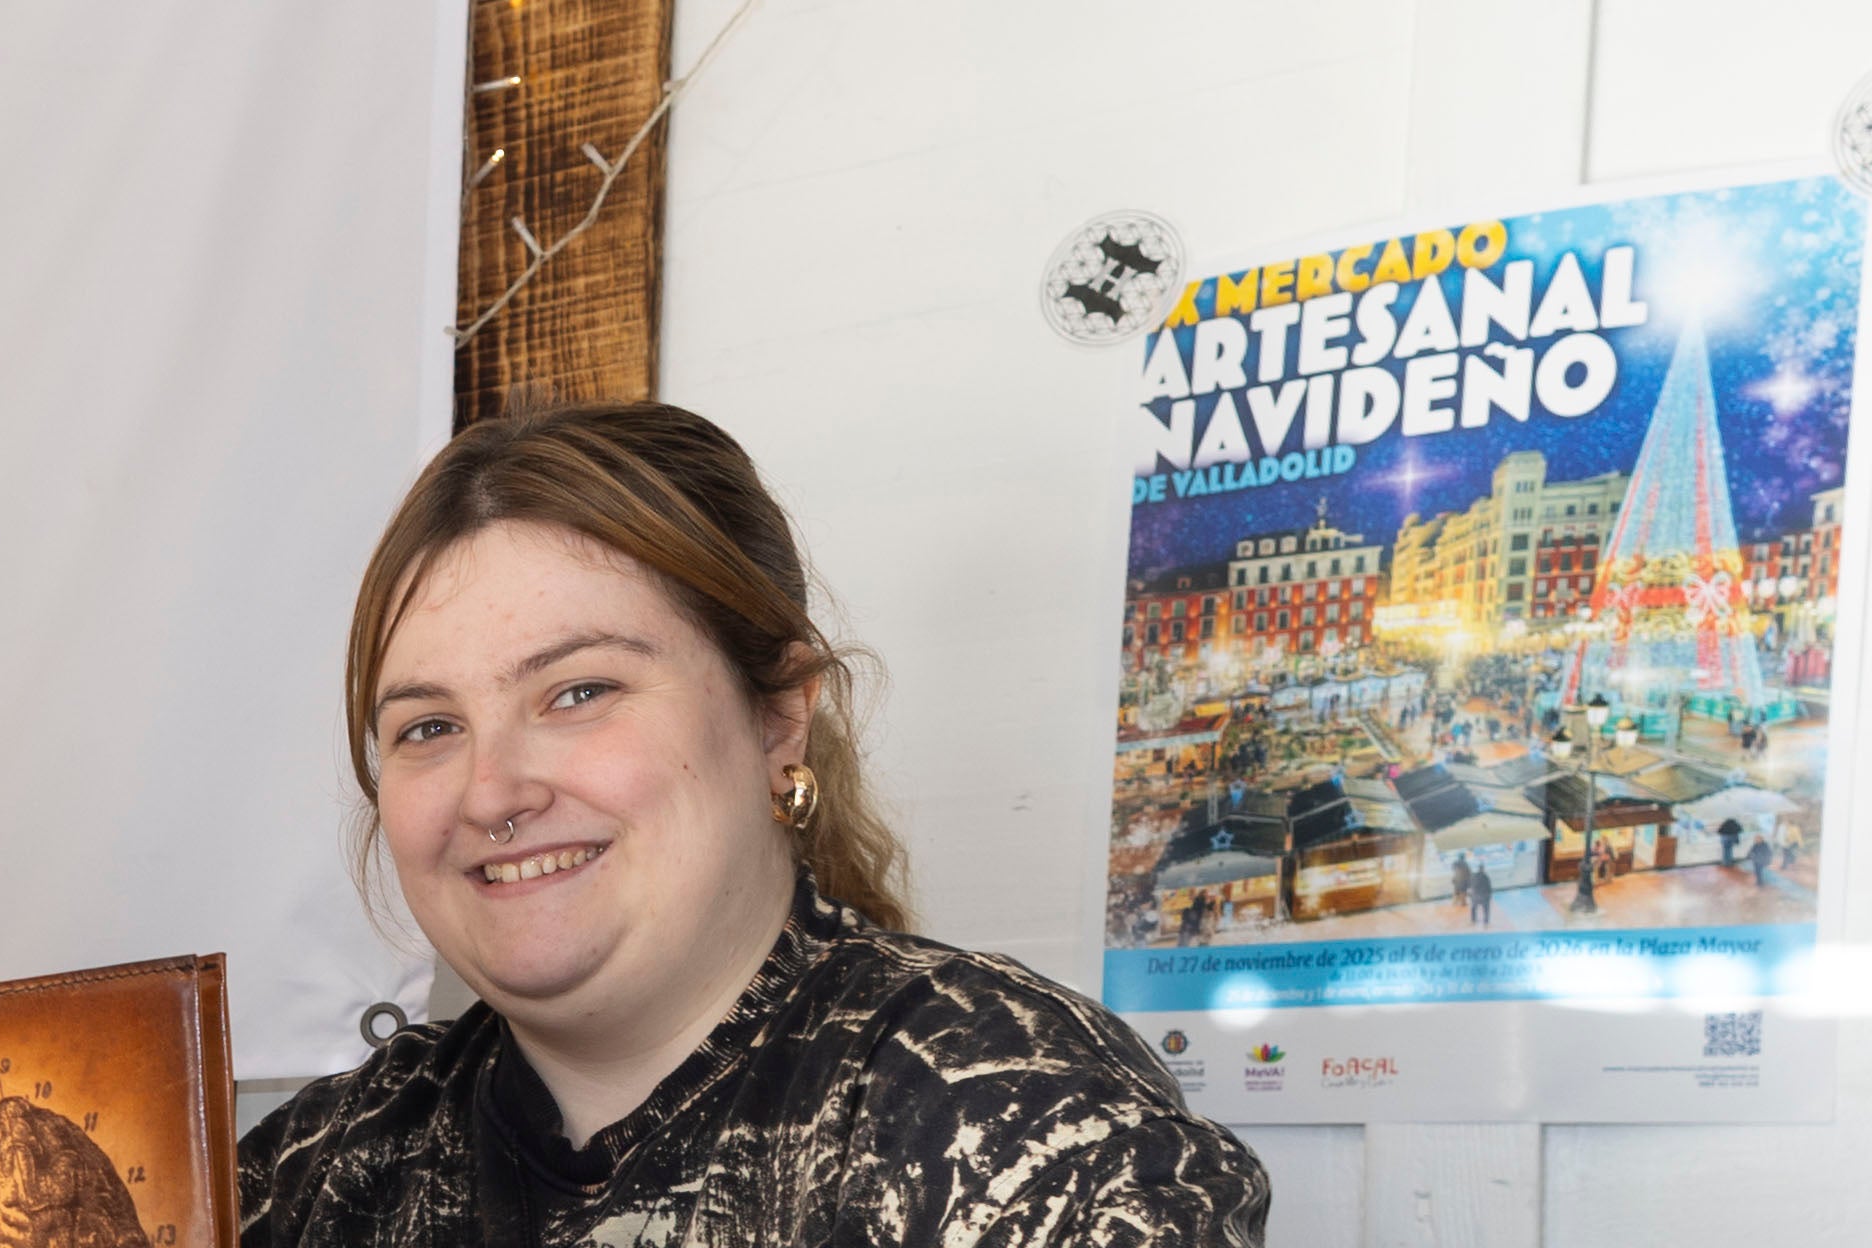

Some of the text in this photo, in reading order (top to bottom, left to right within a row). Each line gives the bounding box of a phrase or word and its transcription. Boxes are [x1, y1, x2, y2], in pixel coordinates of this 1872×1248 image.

[1149, 219, 1508, 333] X MERCADO
[1141, 246, 1648, 401] ARTESANAL
[1135, 332, 1618, 476] NAVIDEÑO
[1131, 443, 1358, 505] DE VALLADOLID
[1148, 935, 1762, 975] Del 27 de noviembre de 2025 al 5 de enero de 2026 en la Plaza Mayor
[0, 1058, 11, 1075] 9
[34, 1081, 53, 1100] 10
[84, 1111, 99, 1132] 11
[127, 1166, 146, 1184] 12
[156, 1223, 177, 1246] 13
